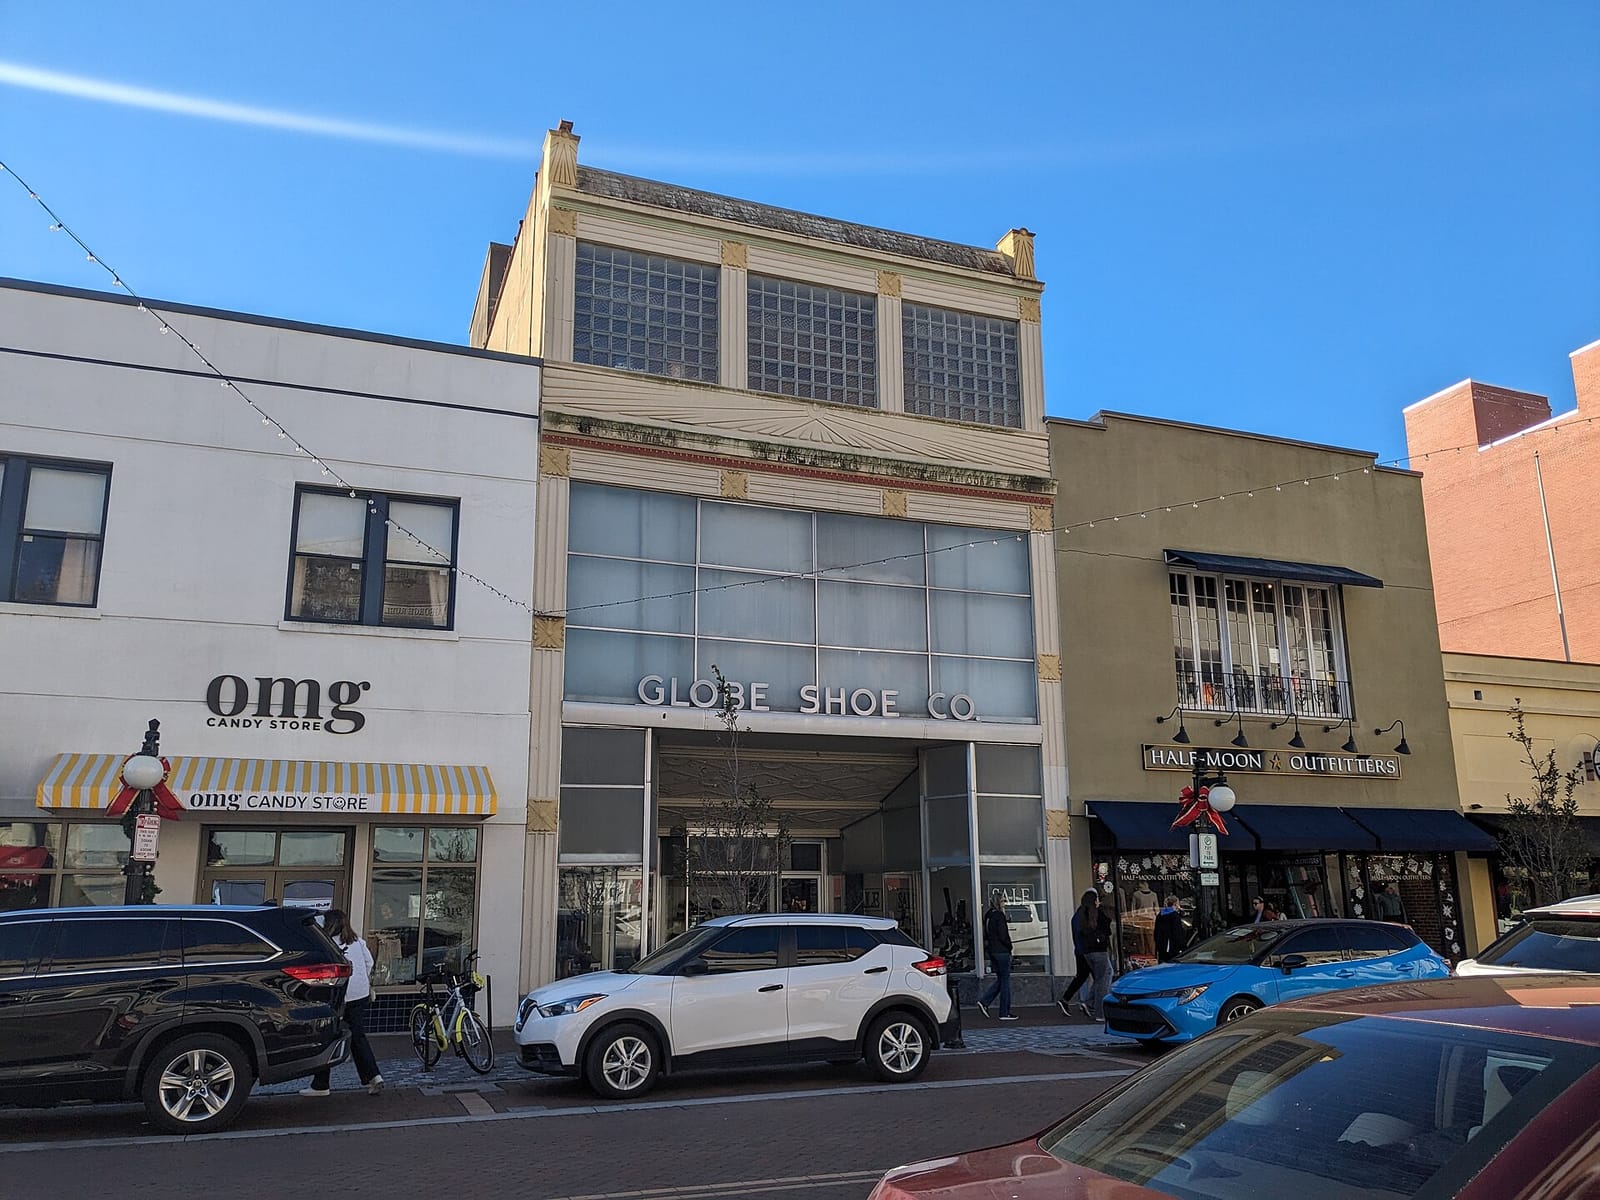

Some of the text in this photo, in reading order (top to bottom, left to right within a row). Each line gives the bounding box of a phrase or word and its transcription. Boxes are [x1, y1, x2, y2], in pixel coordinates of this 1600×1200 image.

[206, 674, 371, 734] omg
[638, 675, 769, 711] GLOBE
[800, 685, 899, 718] SHOE
[206, 717, 321, 731] CANDY STORE
[1151, 750, 1396, 774] HALF-MOON OUTFITTERS
[190, 793, 242, 811] omg
[247, 795, 307, 809] CANDY
